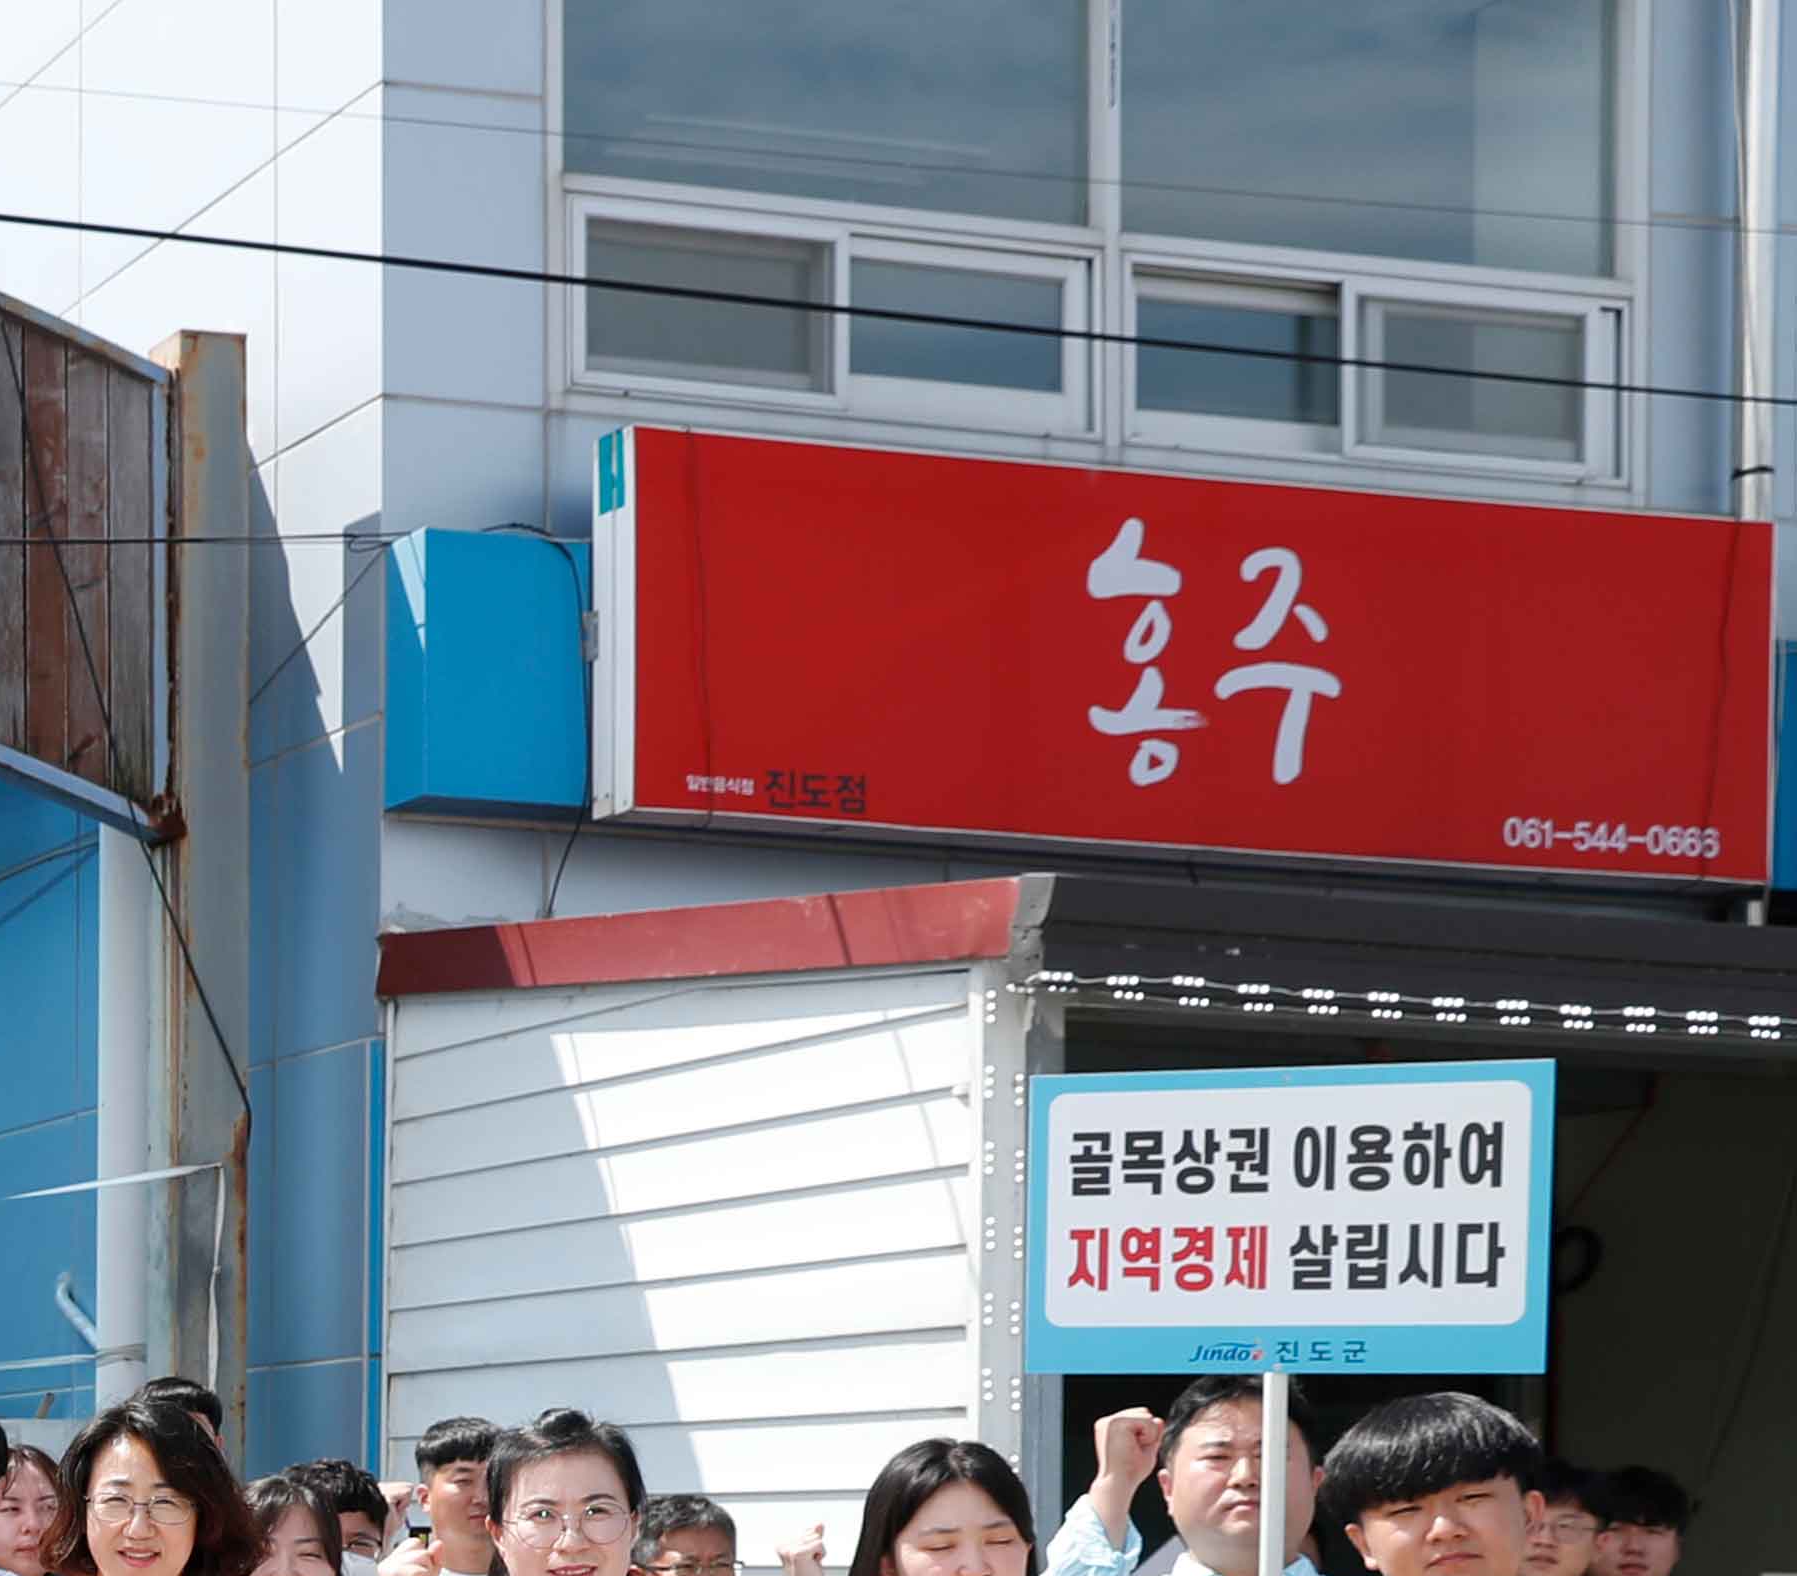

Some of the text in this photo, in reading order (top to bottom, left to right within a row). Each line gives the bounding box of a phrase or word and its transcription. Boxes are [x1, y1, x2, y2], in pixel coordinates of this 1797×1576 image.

[1087, 517, 1343, 787] 홍주
[764, 768, 868, 815] 진도점
[1068, 1120, 1505, 1197] 골목상권 이용하여
[1066, 1221, 1506, 1293] 지역경제 살립시다
[1189, 1342, 1251, 1363] Jindo
[1274, 1340, 1368, 1364] 진도군
